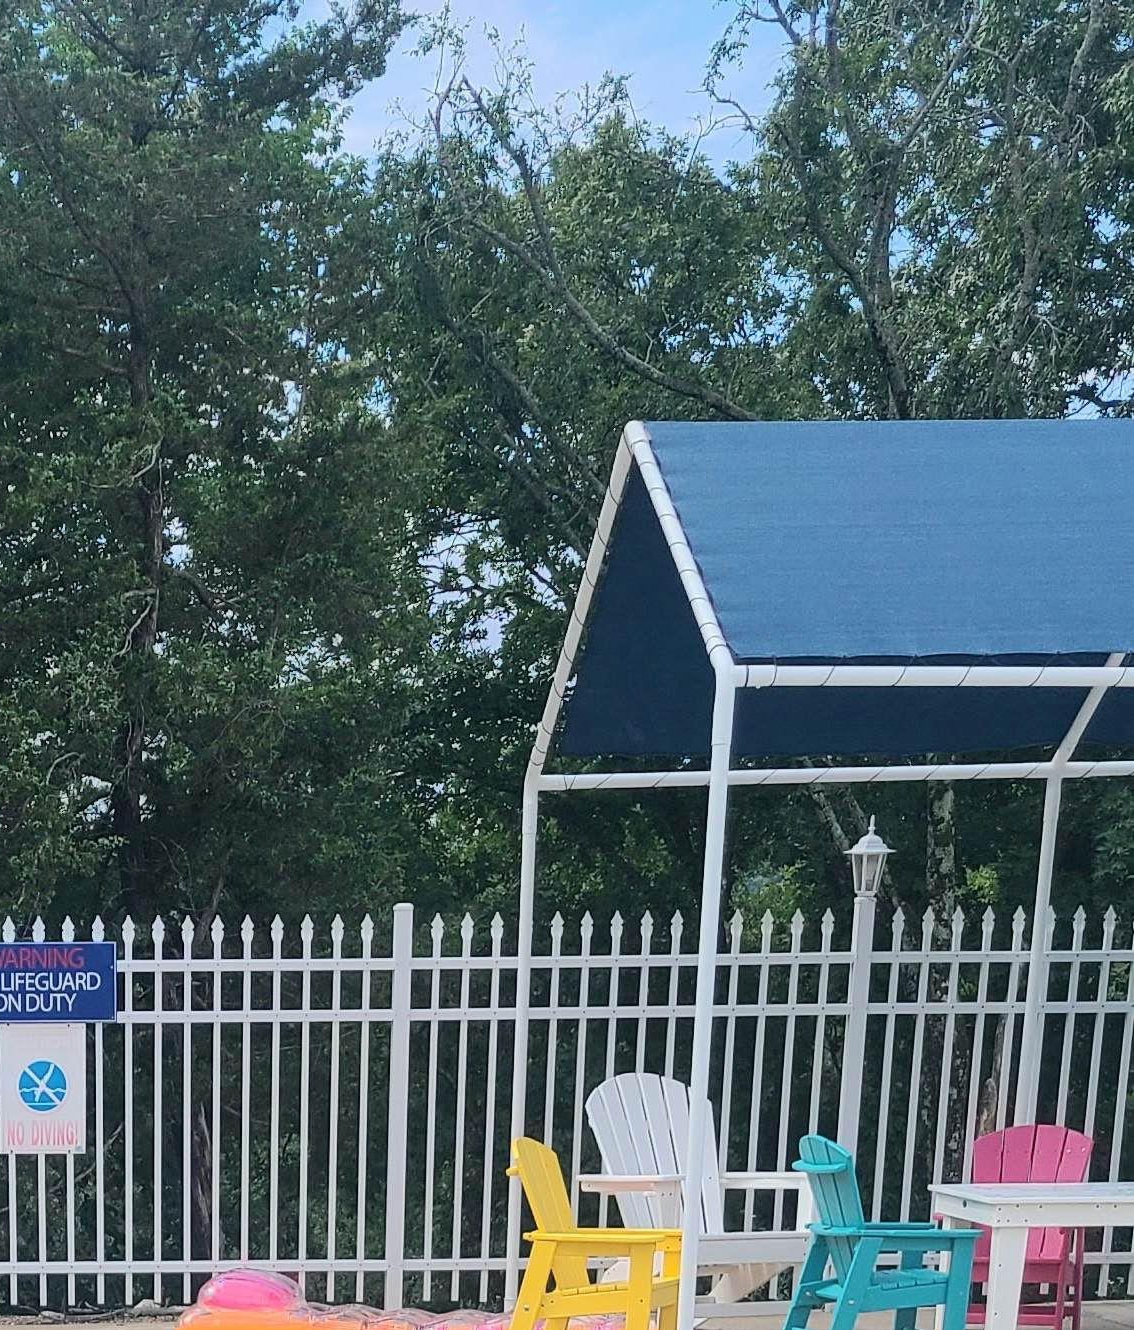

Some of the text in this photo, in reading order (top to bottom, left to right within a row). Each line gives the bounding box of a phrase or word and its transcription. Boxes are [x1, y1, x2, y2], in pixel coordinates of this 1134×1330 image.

[1, 972, 101, 991] LIFEGUARD
[26, 993, 77, 1012] DUTY
[7, 1119, 79, 1145] NO DIVING!
